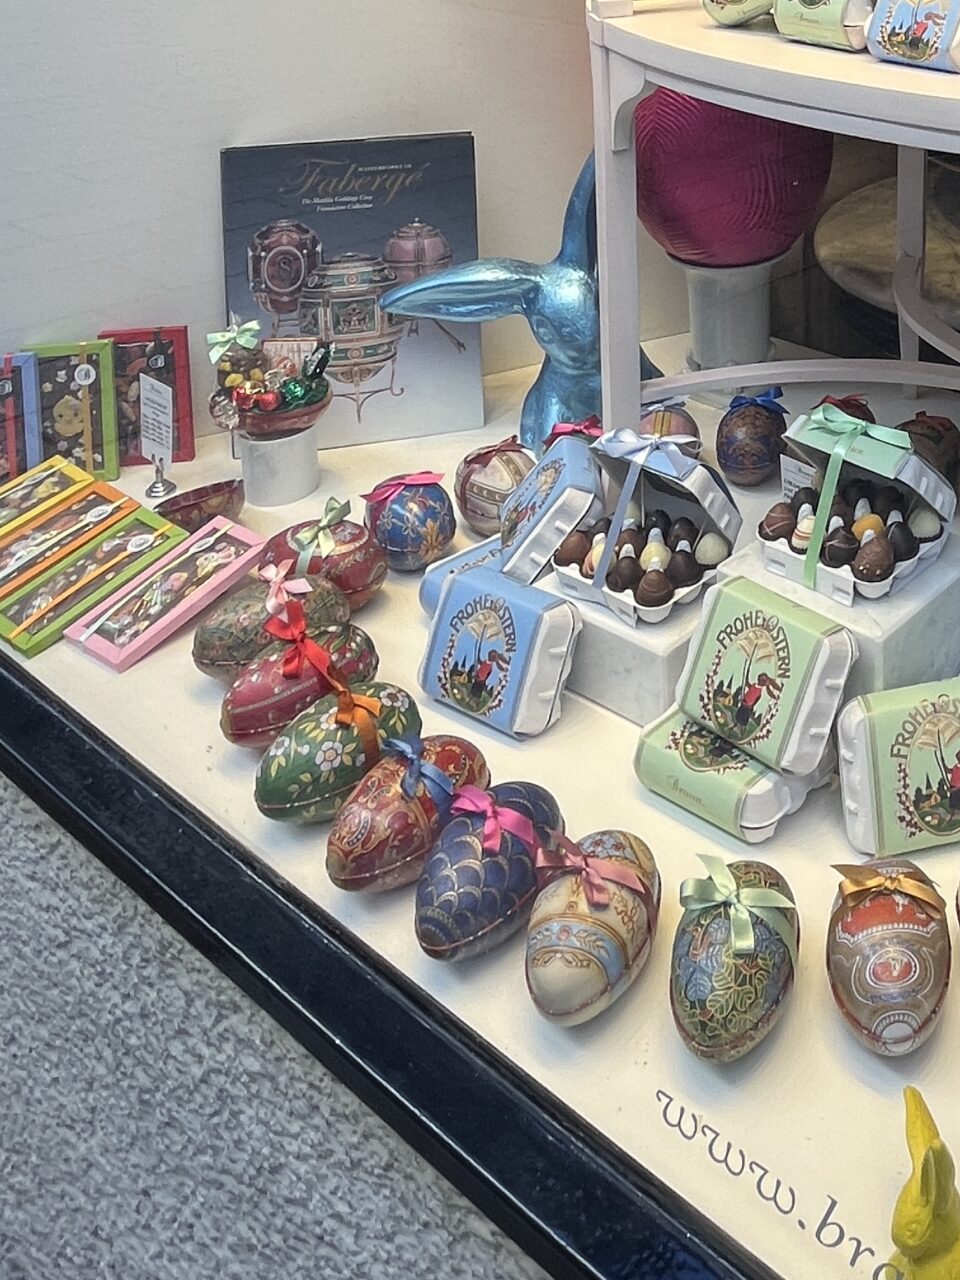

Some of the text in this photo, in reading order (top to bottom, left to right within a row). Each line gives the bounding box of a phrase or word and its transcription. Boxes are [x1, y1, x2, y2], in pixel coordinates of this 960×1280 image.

[450, 593, 517, 653] FROHE OSTERN
[716, 609, 791, 680] FROHE OSTERN
[890, 698, 933, 760] FROHE
